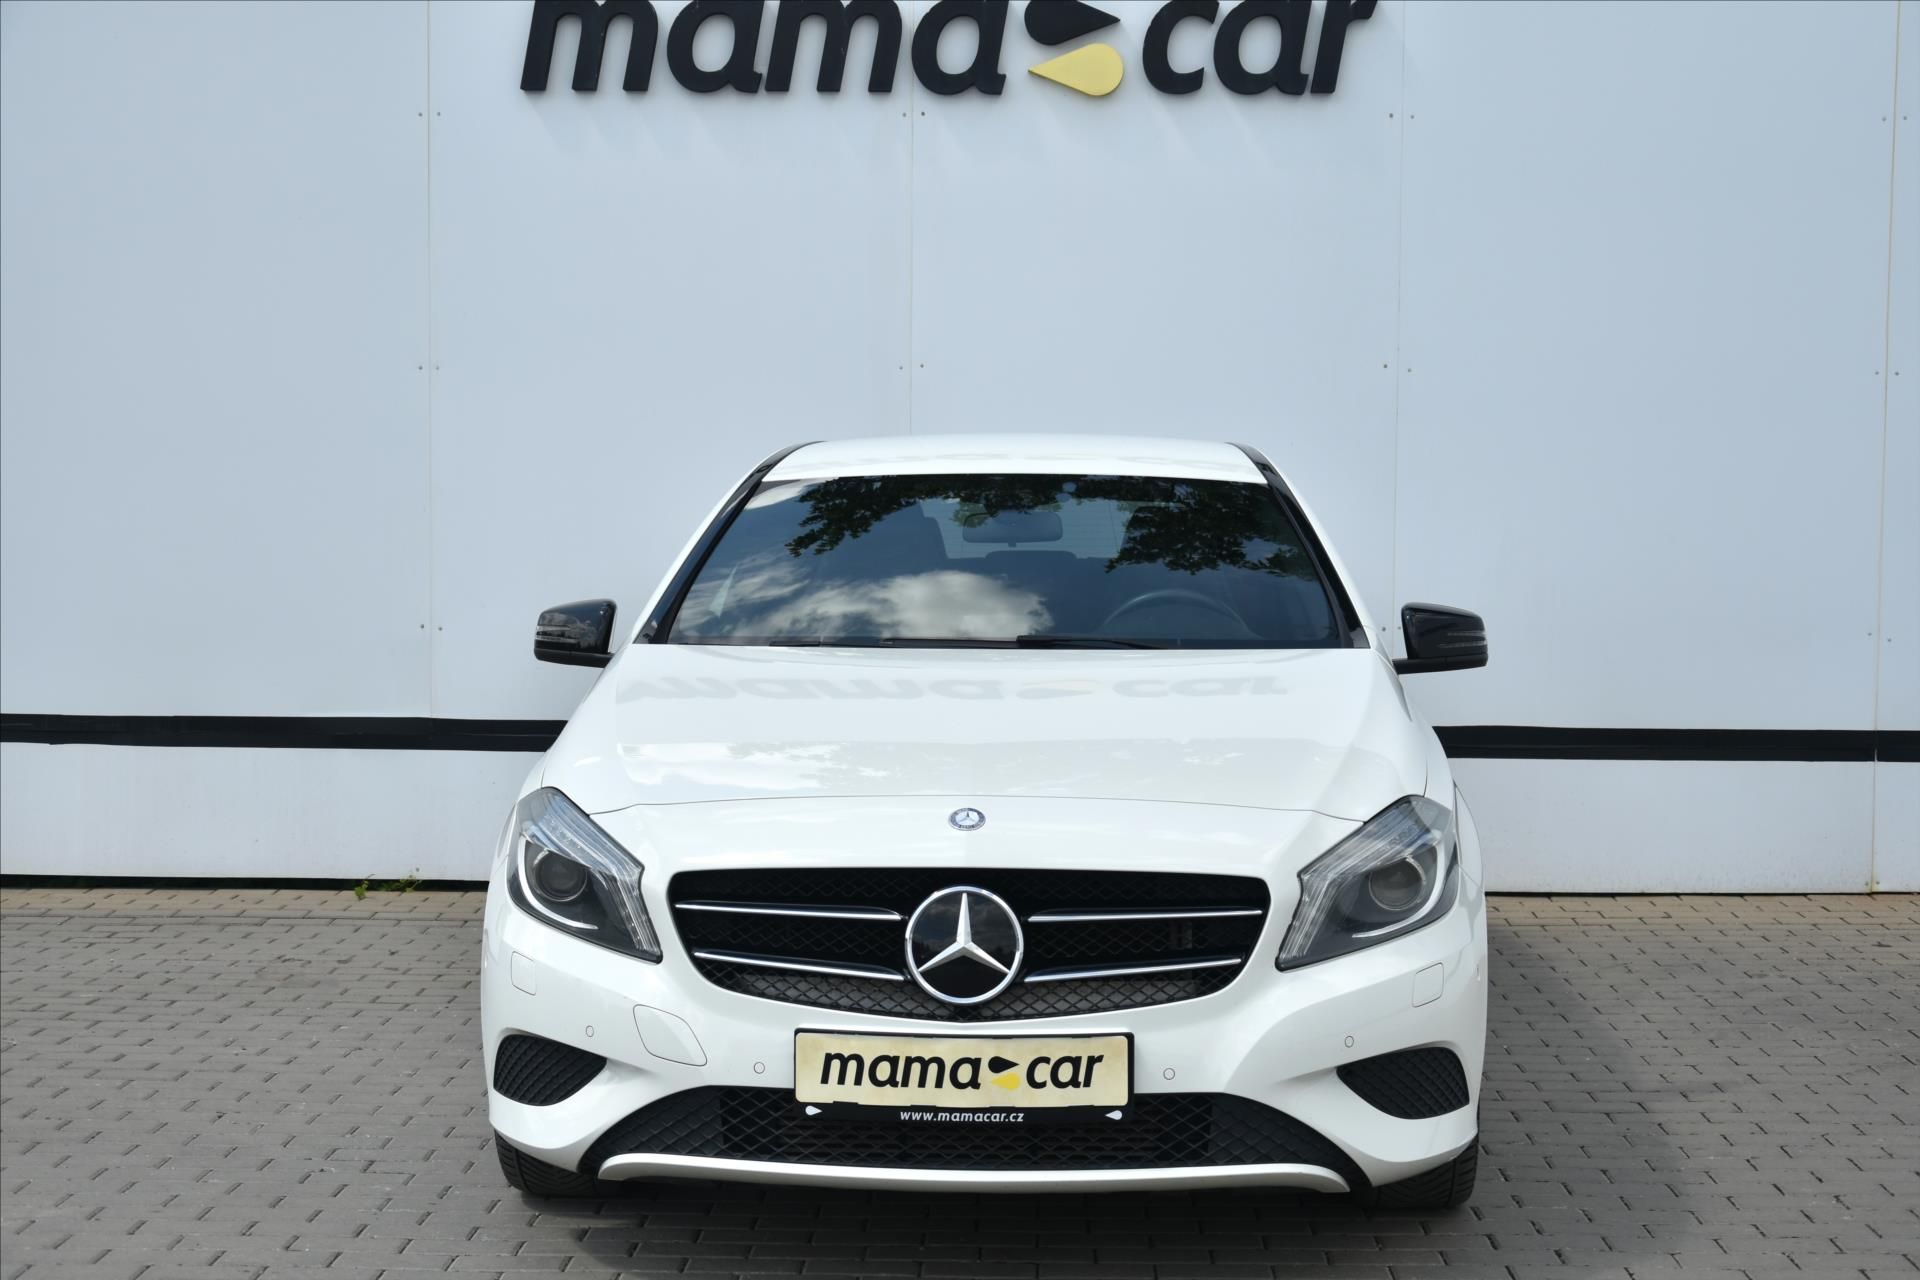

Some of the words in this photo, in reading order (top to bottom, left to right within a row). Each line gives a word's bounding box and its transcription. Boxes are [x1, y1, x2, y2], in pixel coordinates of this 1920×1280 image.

[520, 0, 1008, 96] mama
[1142, 0, 1380, 97] car
[820, 1052, 982, 1090] mama
[1026, 1054, 1104, 1089] car
[900, 1110, 1025, 1122] www.mamacar.cz
